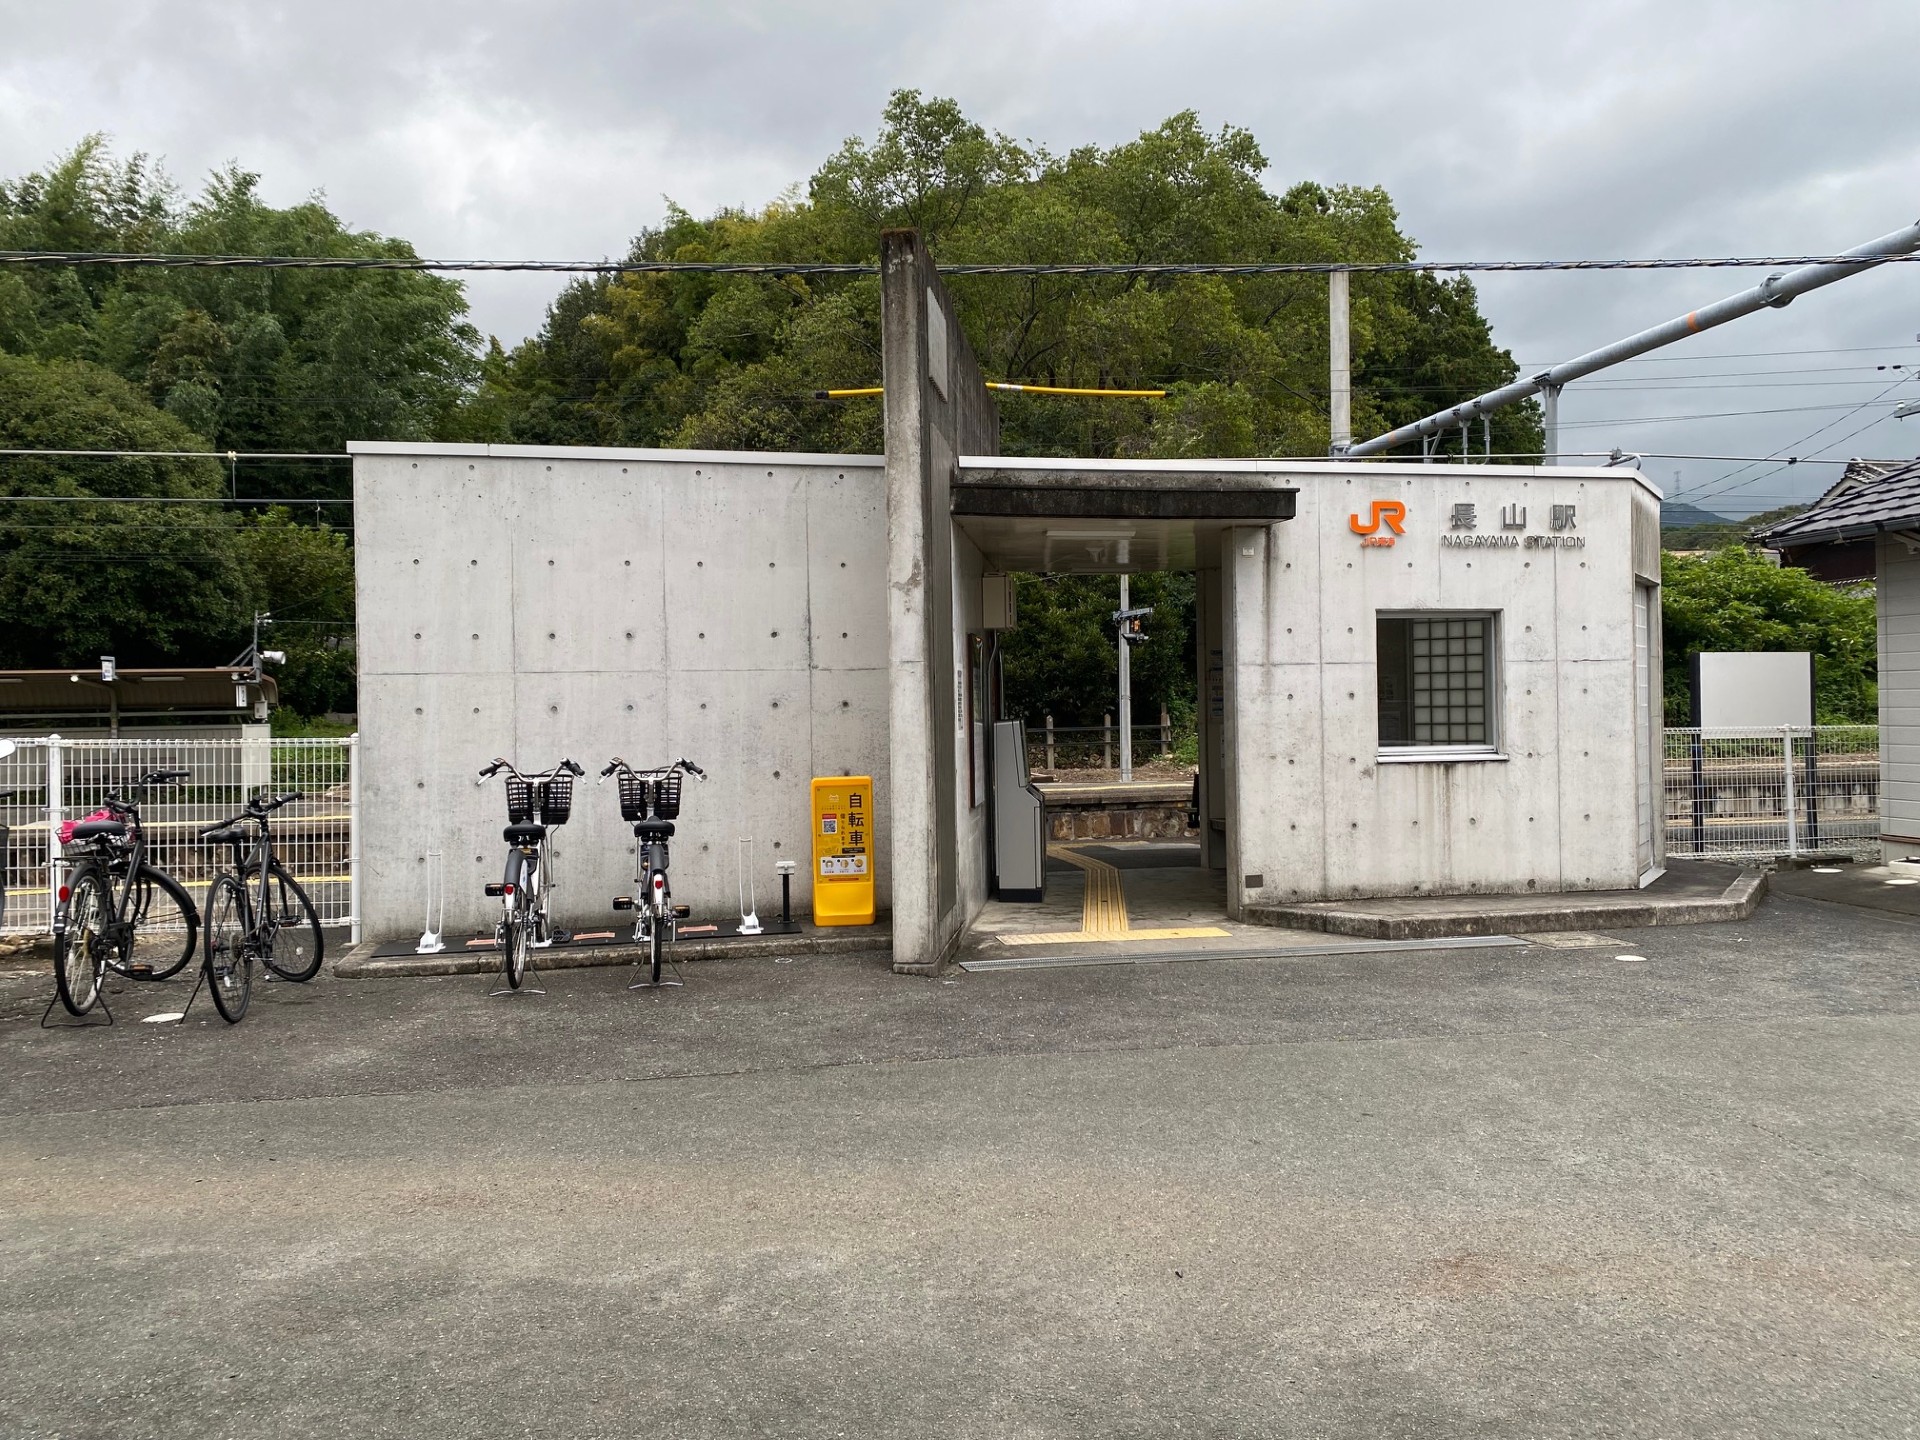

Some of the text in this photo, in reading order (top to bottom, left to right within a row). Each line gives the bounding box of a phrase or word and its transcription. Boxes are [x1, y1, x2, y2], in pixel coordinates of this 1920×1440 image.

[1350, 500, 1406, 534] JR
[1451, 503, 1577, 529] 長山駅
[1442, 535, 1586, 549] NAGAYAMA STATION
[848, 792, 864, 846] 自転車
